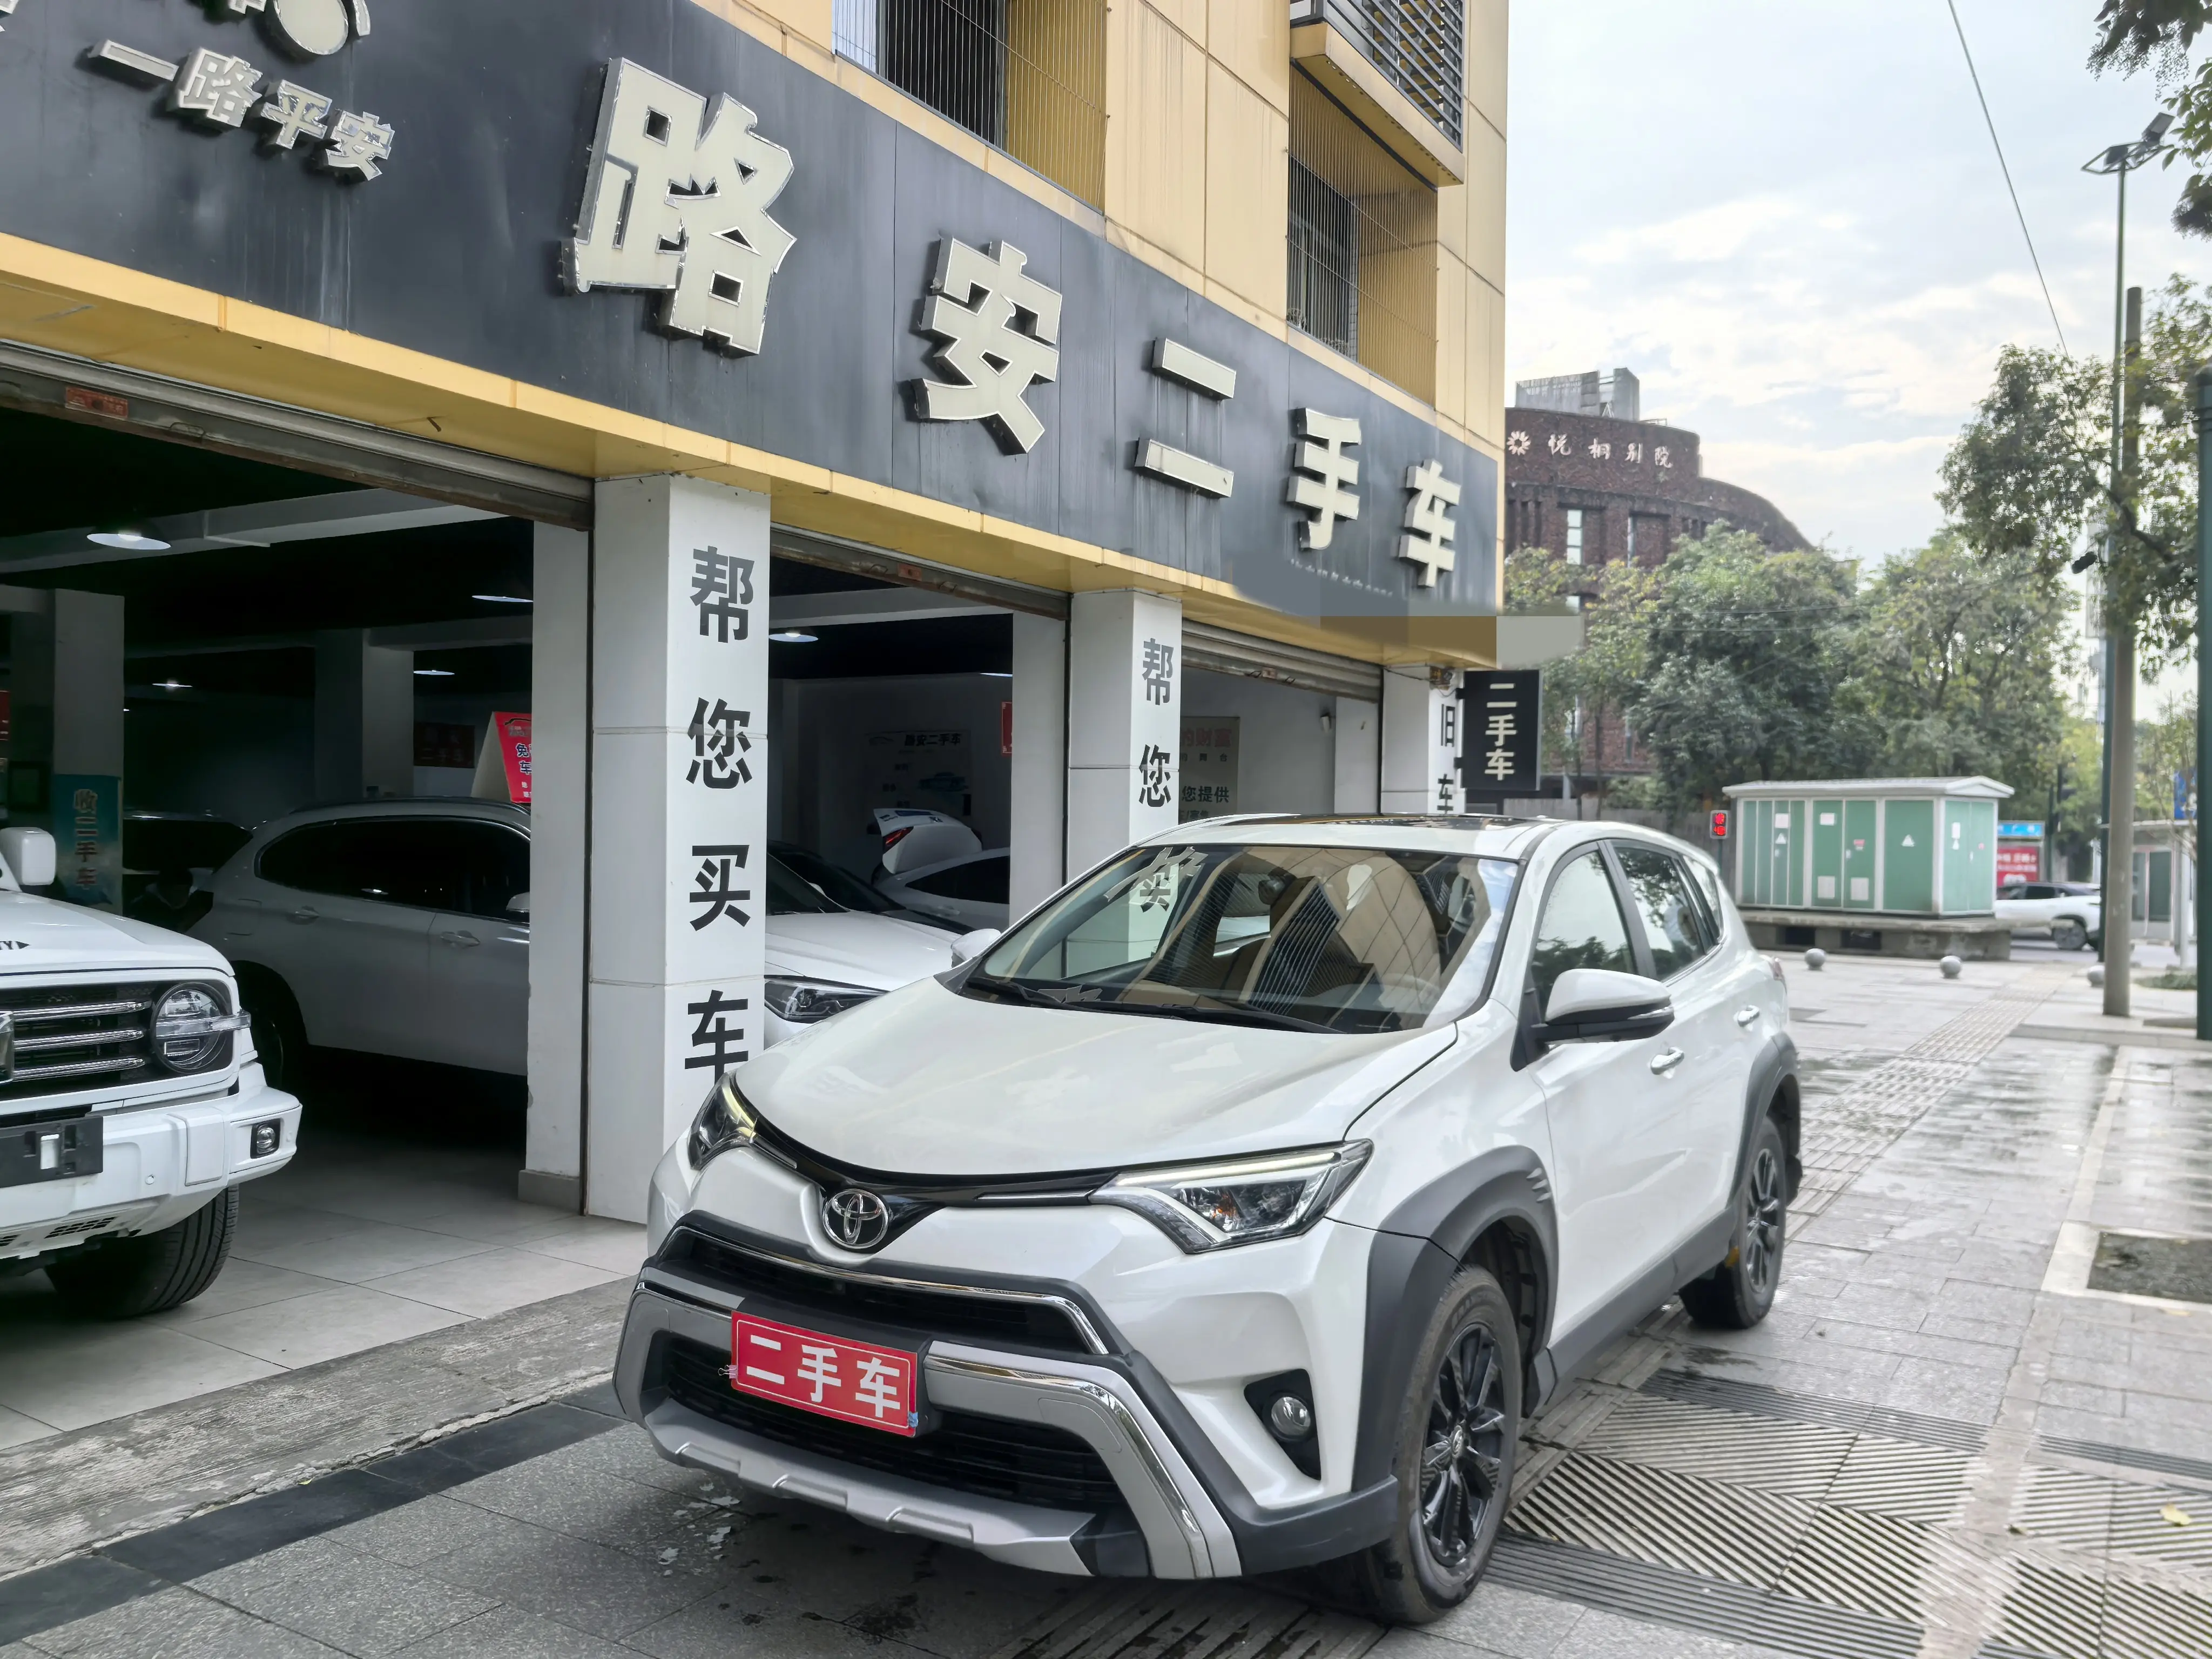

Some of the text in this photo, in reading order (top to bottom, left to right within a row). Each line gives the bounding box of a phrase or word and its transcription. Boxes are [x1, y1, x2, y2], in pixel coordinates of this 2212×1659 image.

[89, 39, 395, 181] 一路平安
[561, 57, 1461, 588] 路安二手车
[1484, 683, 1518, 781] 二手车
[684, 545, 755, 1087] 帮您买车
[746, 1334, 901, 1418] 二手车
